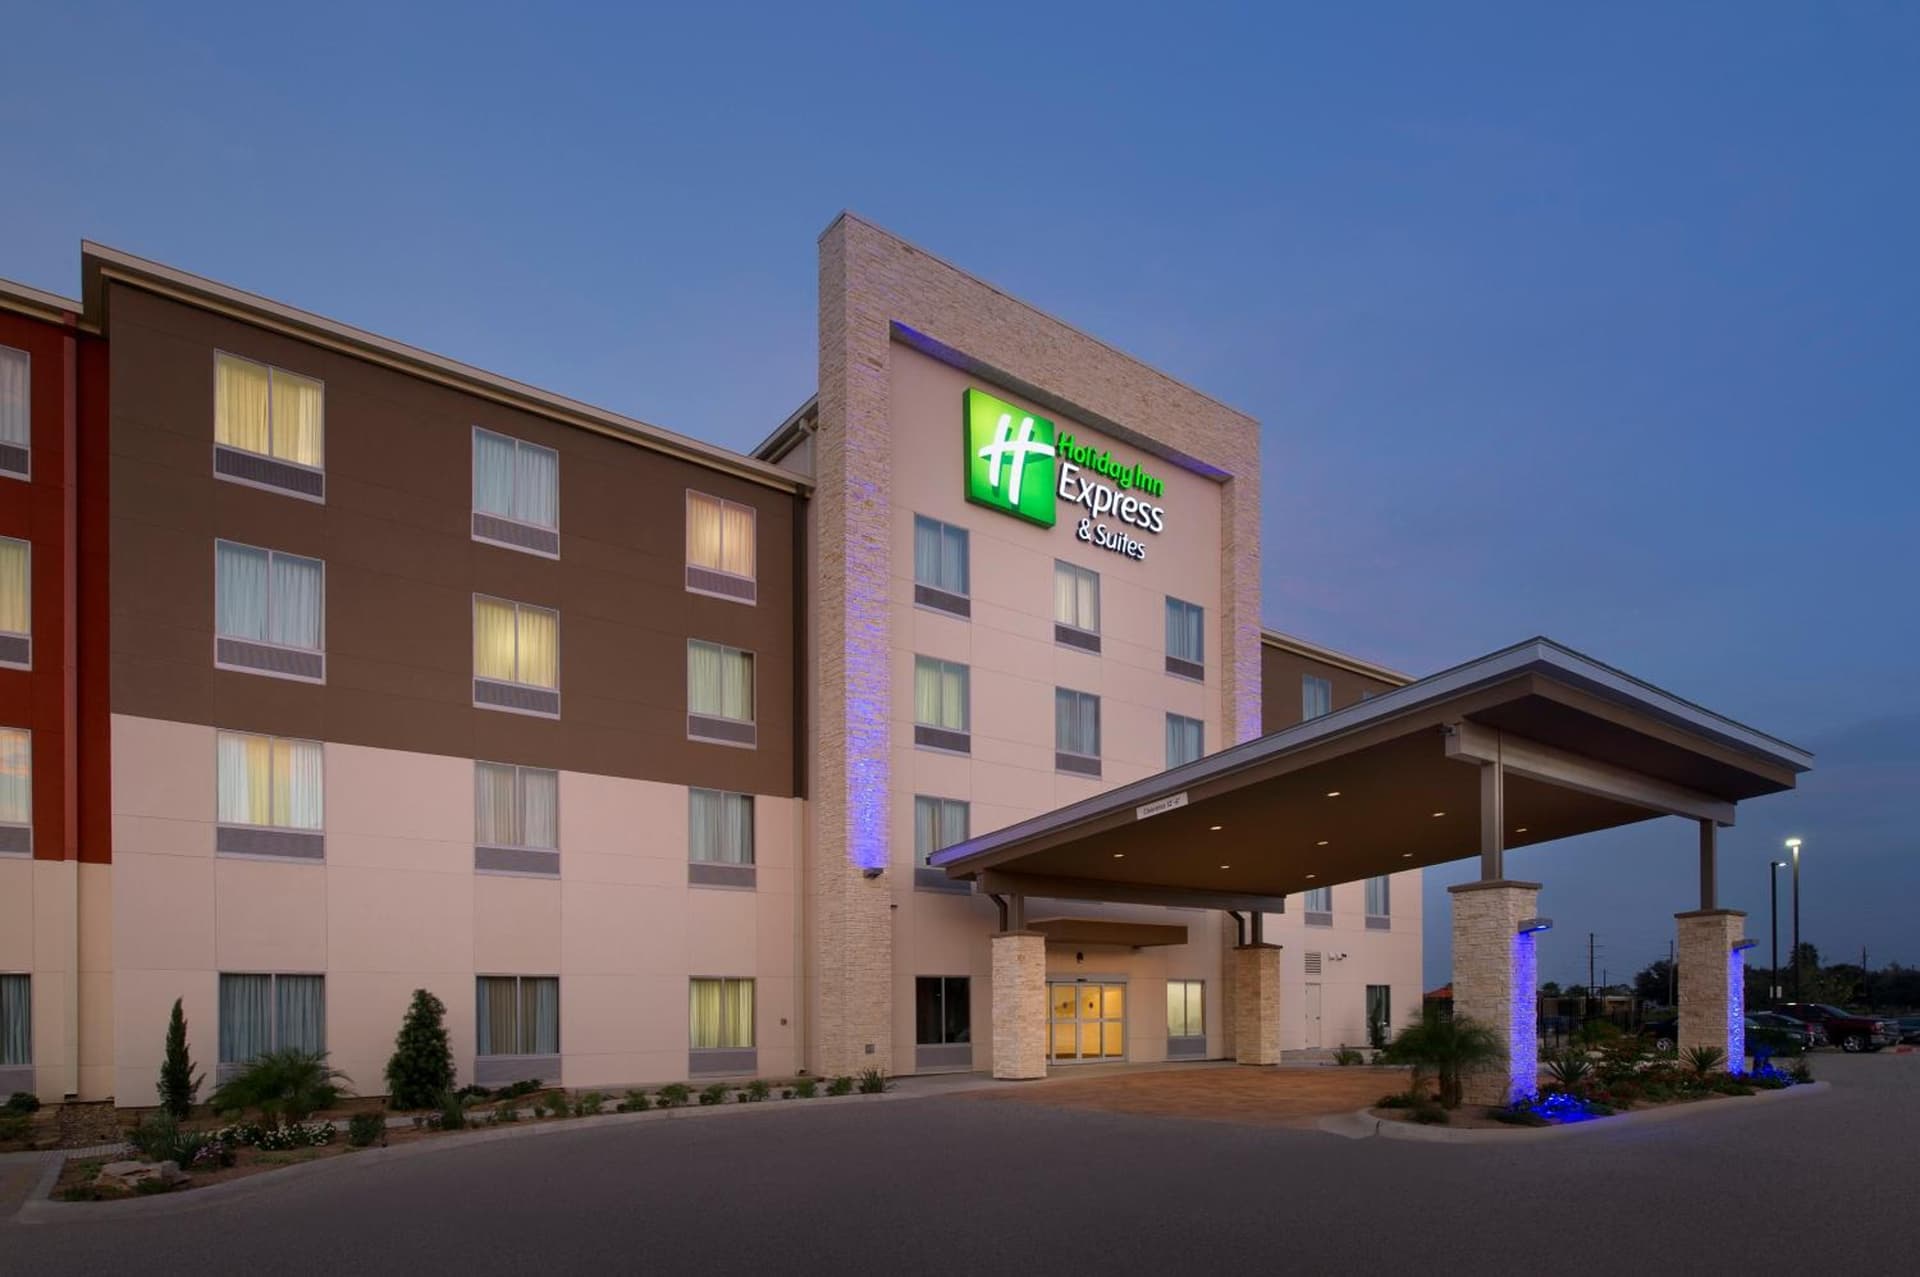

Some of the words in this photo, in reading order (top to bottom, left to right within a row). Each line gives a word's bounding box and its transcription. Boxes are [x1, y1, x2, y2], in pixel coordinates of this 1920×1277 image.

[1058, 432, 1133, 488] Holiday
[1134, 464, 1164, 496] Inn
[1058, 461, 1164, 532] Express
[1078, 518, 1091, 541] &
[1095, 523, 1146, 560] Suites
